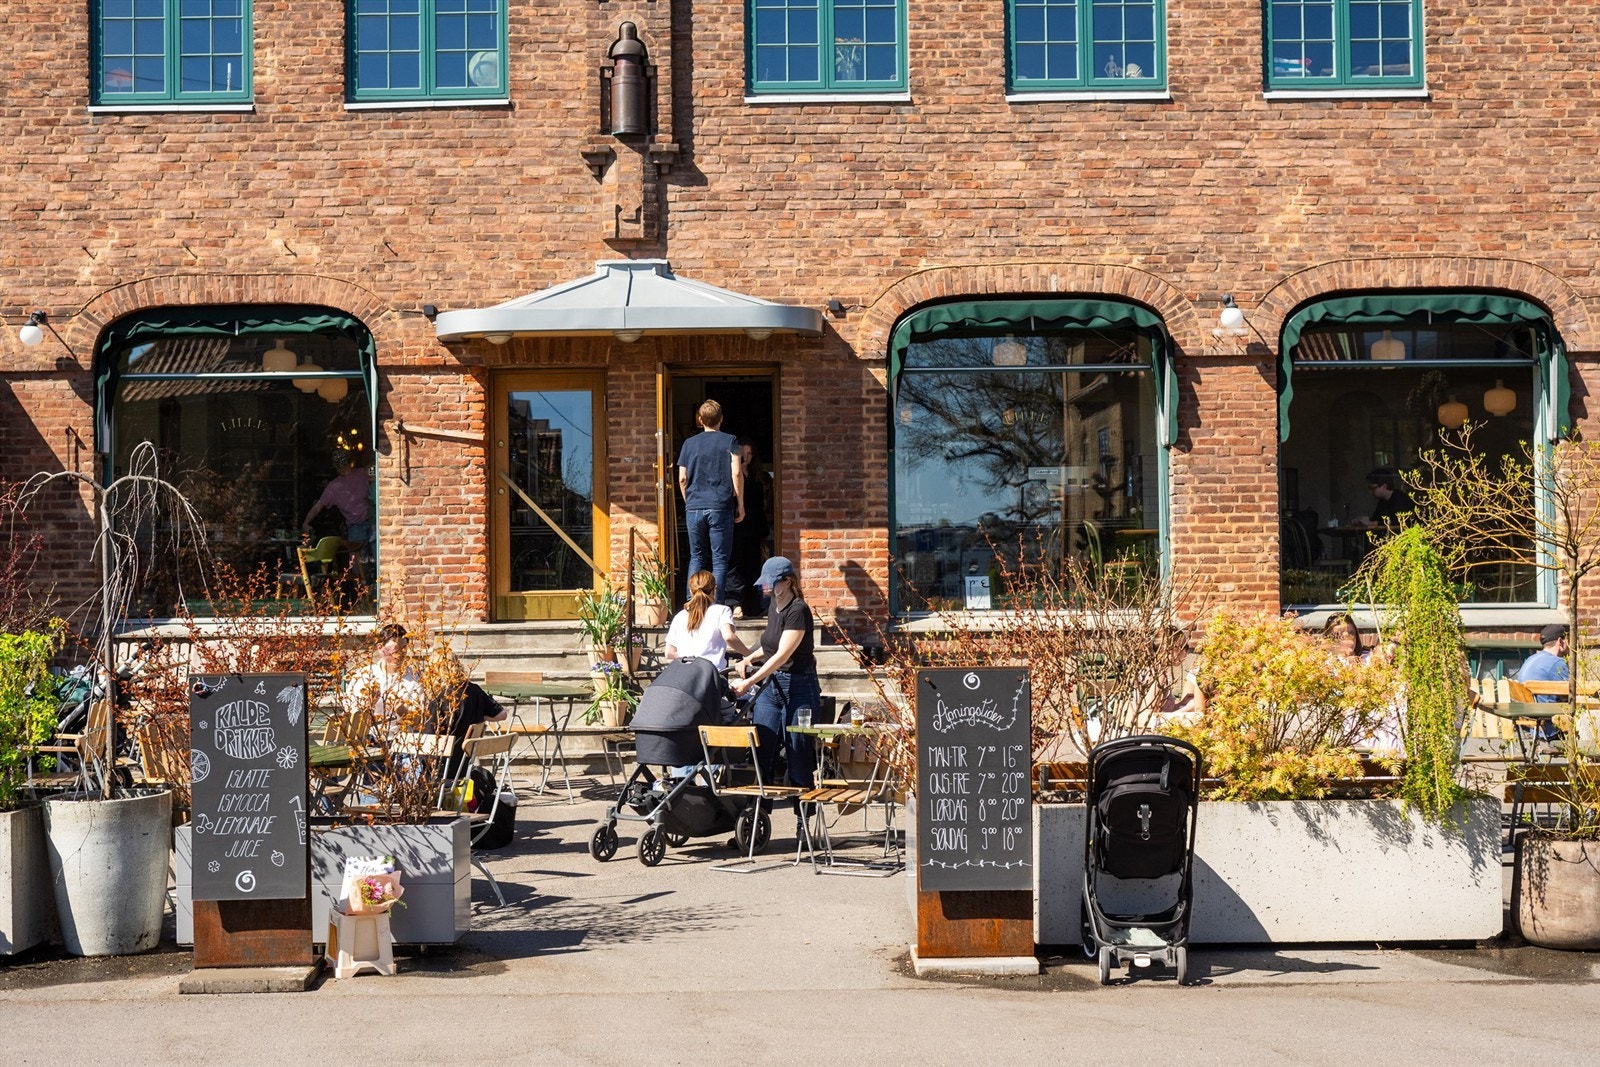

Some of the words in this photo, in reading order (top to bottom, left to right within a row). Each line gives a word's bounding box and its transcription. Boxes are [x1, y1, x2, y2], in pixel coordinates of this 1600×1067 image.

[215, 699, 271, 729] KALDE
[225, 769, 275, 789] ISLATTE
[217, 793, 270, 812] ISMOCCA
[930, 798, 968, 824] LØRDAG
[213, 815, 277, 835] LEMONADE
[225, 839, 264, 857] JUICE
[930, 827, 968, 853] SØNDAG
